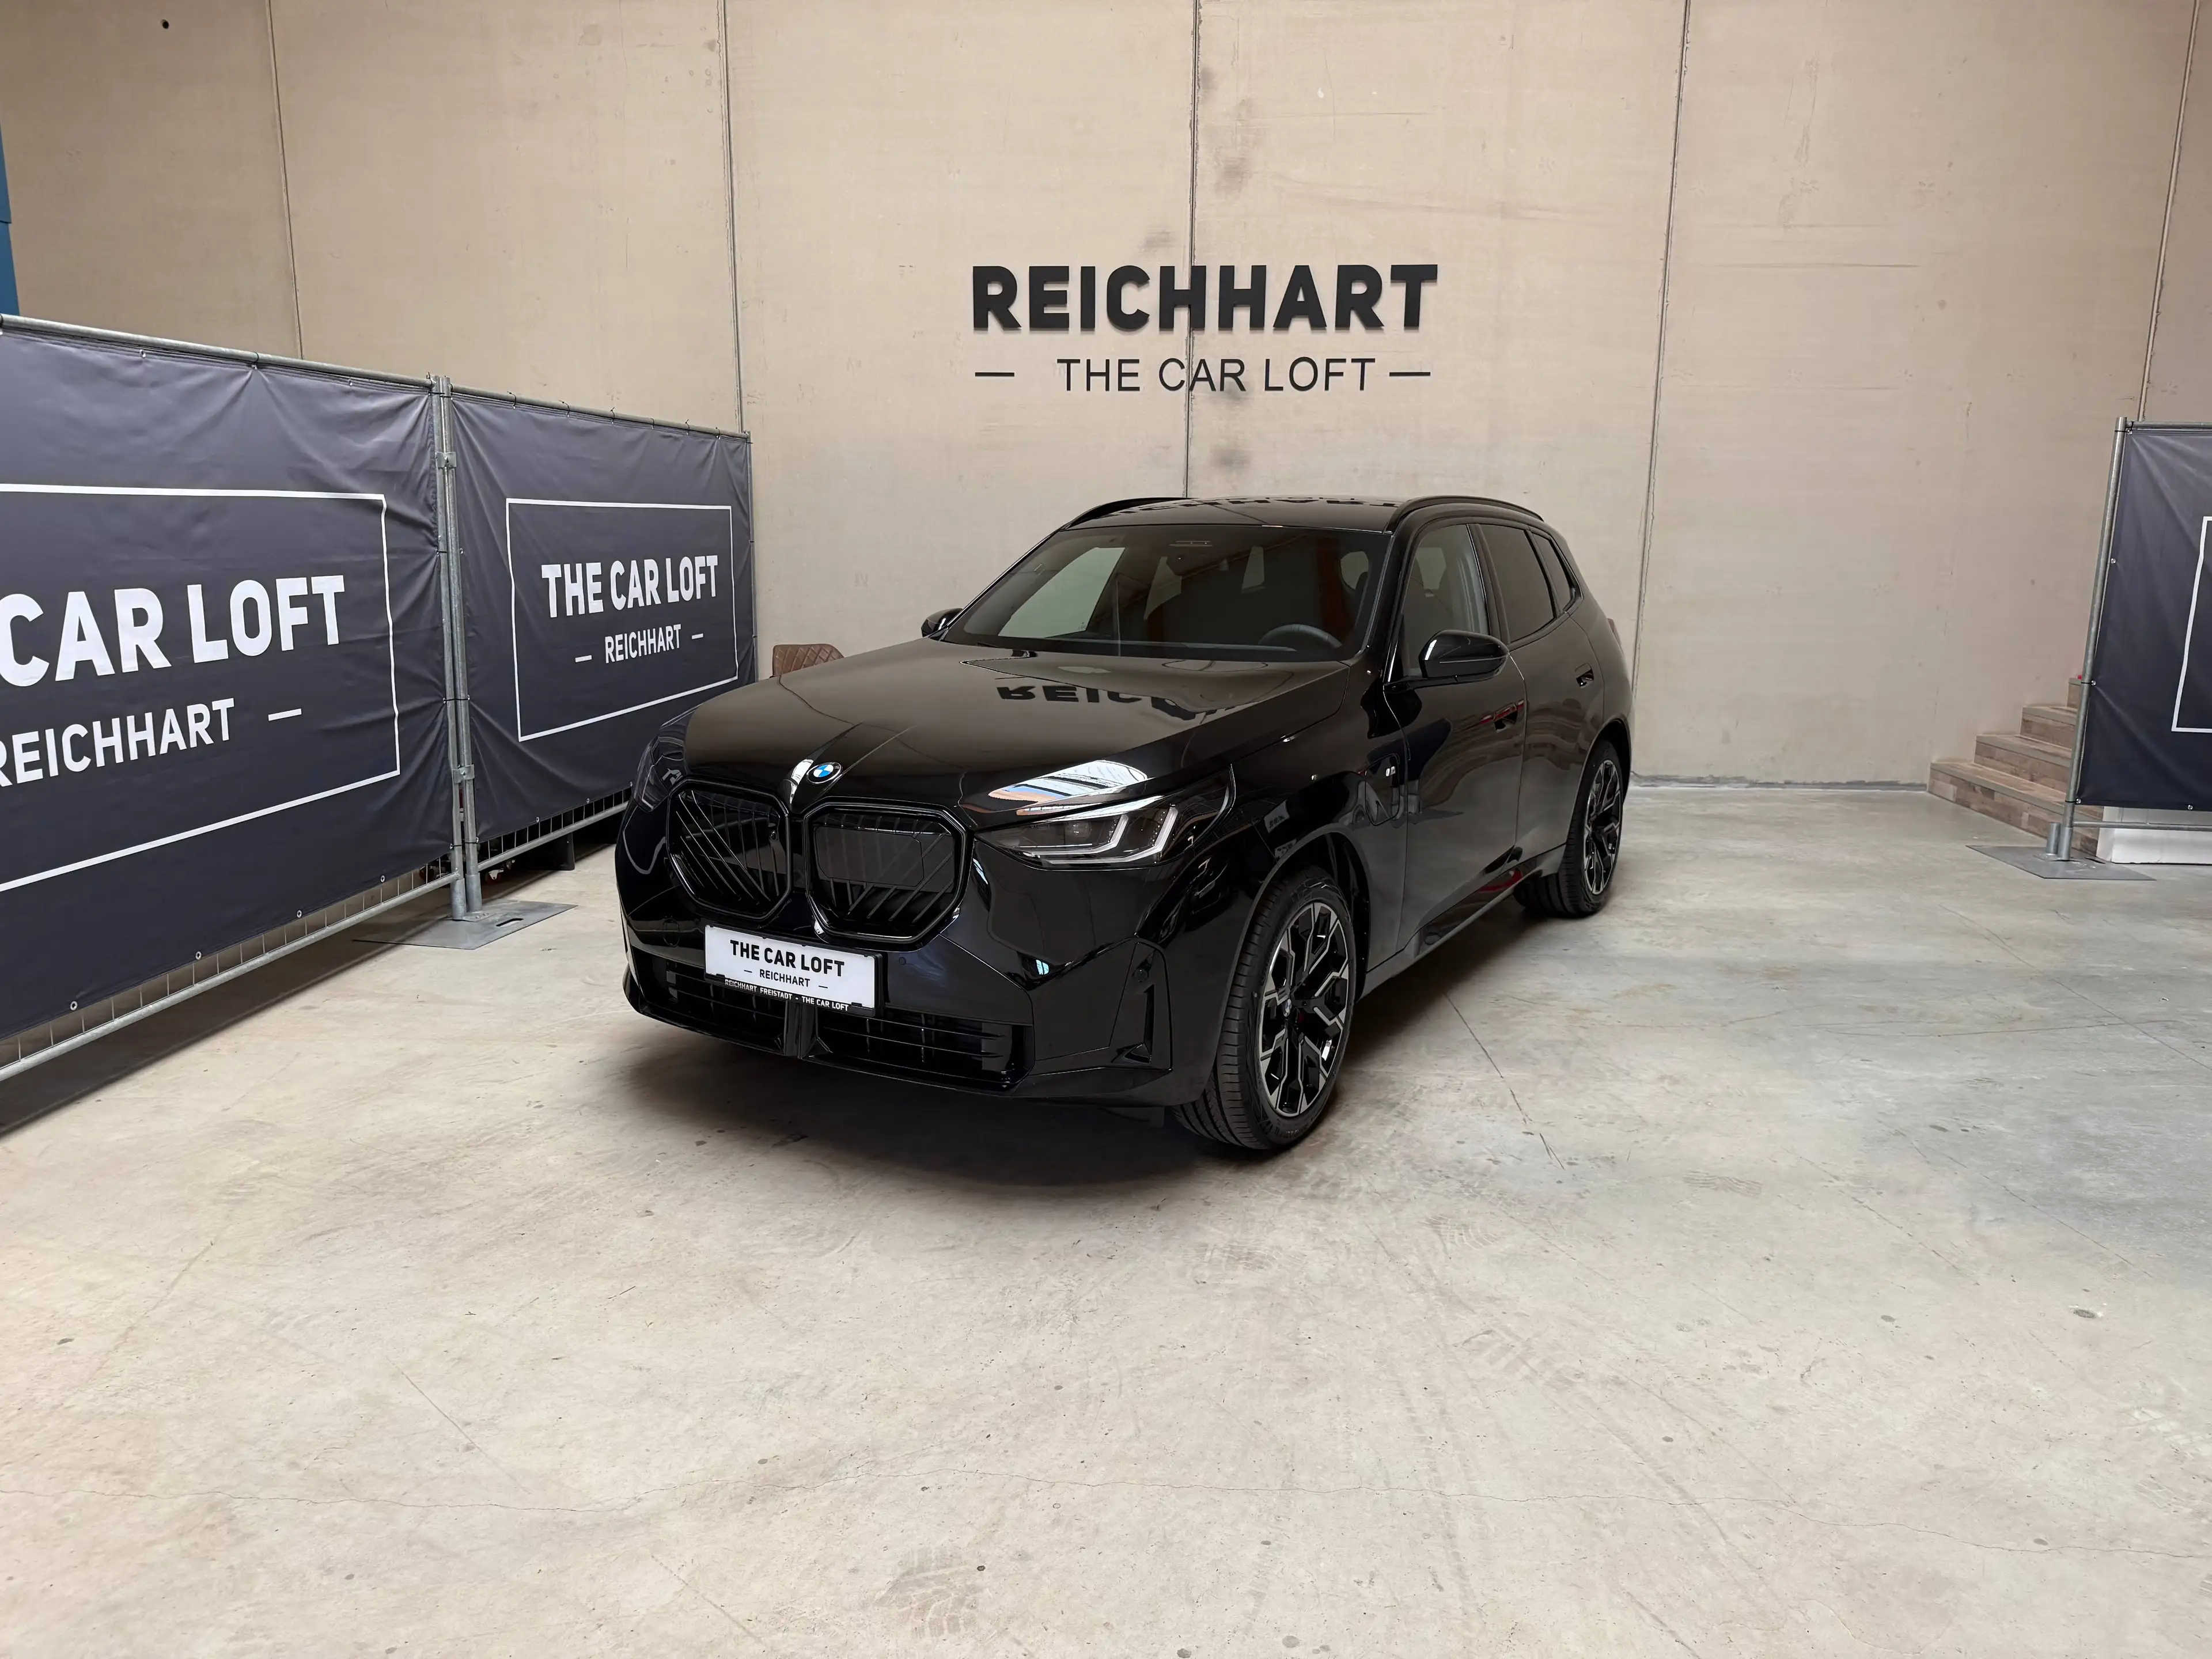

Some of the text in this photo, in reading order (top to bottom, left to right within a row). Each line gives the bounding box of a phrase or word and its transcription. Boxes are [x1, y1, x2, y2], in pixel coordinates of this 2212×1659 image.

[973, 264, 1437, 332] REICHHART
[1057, 357, 1376, 392] THE CAR LOFT
[541, 555, 718, 618] THE CAR LOFT
[0, 575, 344, 687] CAR LOFT
[605, 624, 681, 664] REICHHART
[730, 940, 844, 977] THE CAR LOFT
[725, 979, 757, 993] REICHHART
[760, 987, 793, 1001] FREISTADT
[801, 996, 815, 1005] THE
[816, 999, 830, 1007] CAR
[831, 1002, 849, 1012] LOFT
[759, 969, 810, 987] REICHHART
